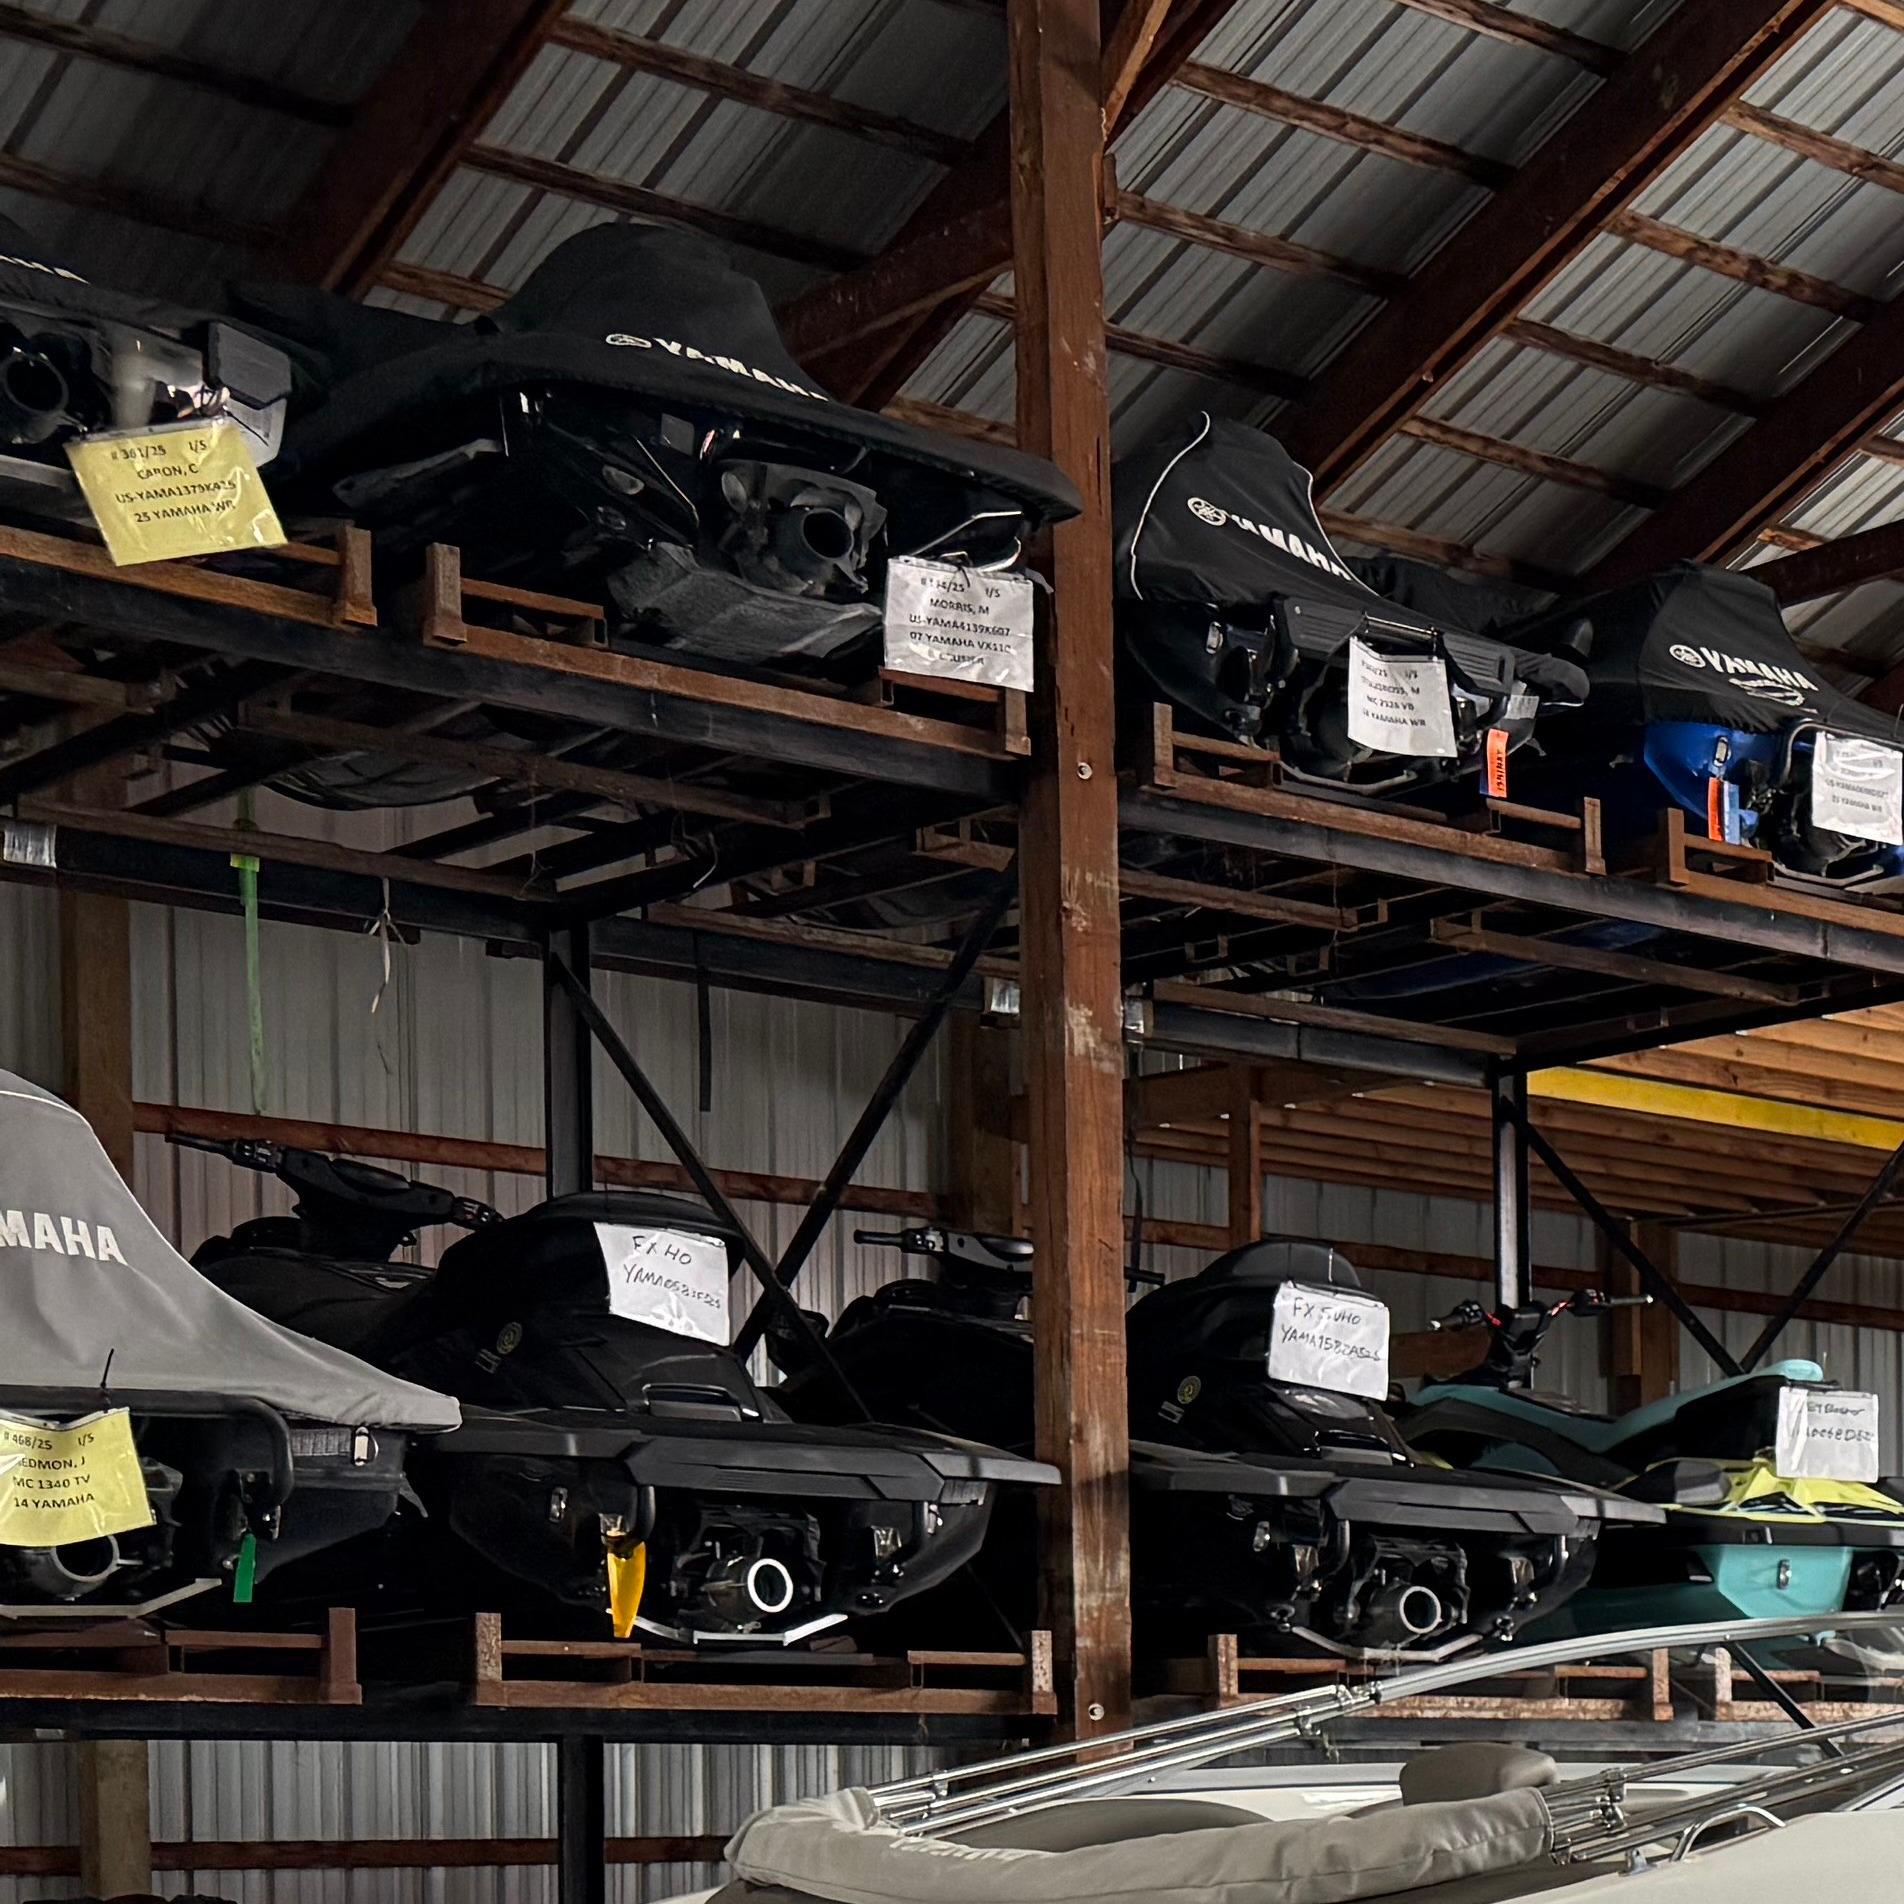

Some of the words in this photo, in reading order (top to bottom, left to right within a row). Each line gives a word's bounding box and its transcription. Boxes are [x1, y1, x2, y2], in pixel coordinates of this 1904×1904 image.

[190, 463, 199, 474] C
[153, 503, 211, 520] YAMAHA
[978, 605, 989, 615] M
[925, 634, 974, 648] YAMAHA
[1700, 647, 1819, 691] YAMAHA
[632, 1235, 657, 1255] FX
[664, 1243, 692, 1265] HO
[1293, 1296, 1315, 1317] FX
[38, 1478, 70, 1490] 1340
[74, 1475, 91, 1485] TV
[15, 1497, 28, 1508] 14
[32, 1493, 95, 1509] YAMAHA
